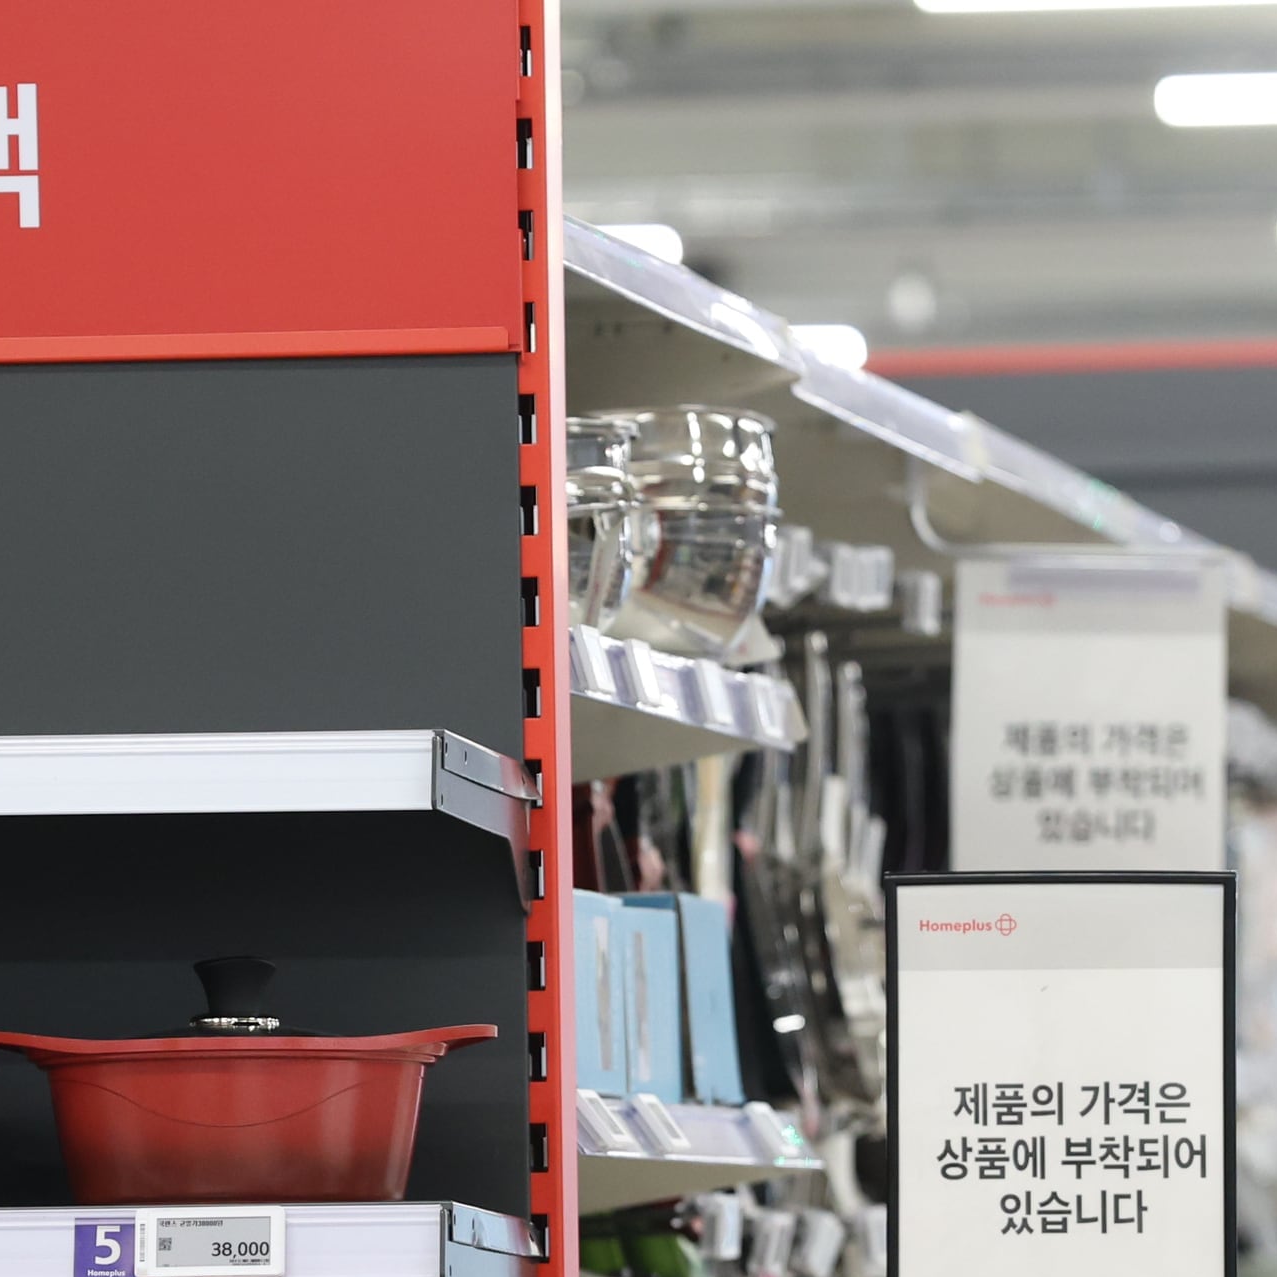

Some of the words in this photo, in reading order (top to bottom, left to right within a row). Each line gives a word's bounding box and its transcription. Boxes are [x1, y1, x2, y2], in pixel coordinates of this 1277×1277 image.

[919, 919, 992, 935] Homeplus
[953, 1082, 1064, 1126] 제품의
[1080, 1081, 1191, 1125] 가격은
[937, 1136, 1046, 1180] 상품에
[1061, 1134, 1207, 1179] 부착되어
[1000, 1190, 1148, 1235] 있습니다
[94, 1225, 121, 1265] 5
[211, 1242, 270, 1259] 38,000
[87, 1269, 125, 1277] Homeplus
